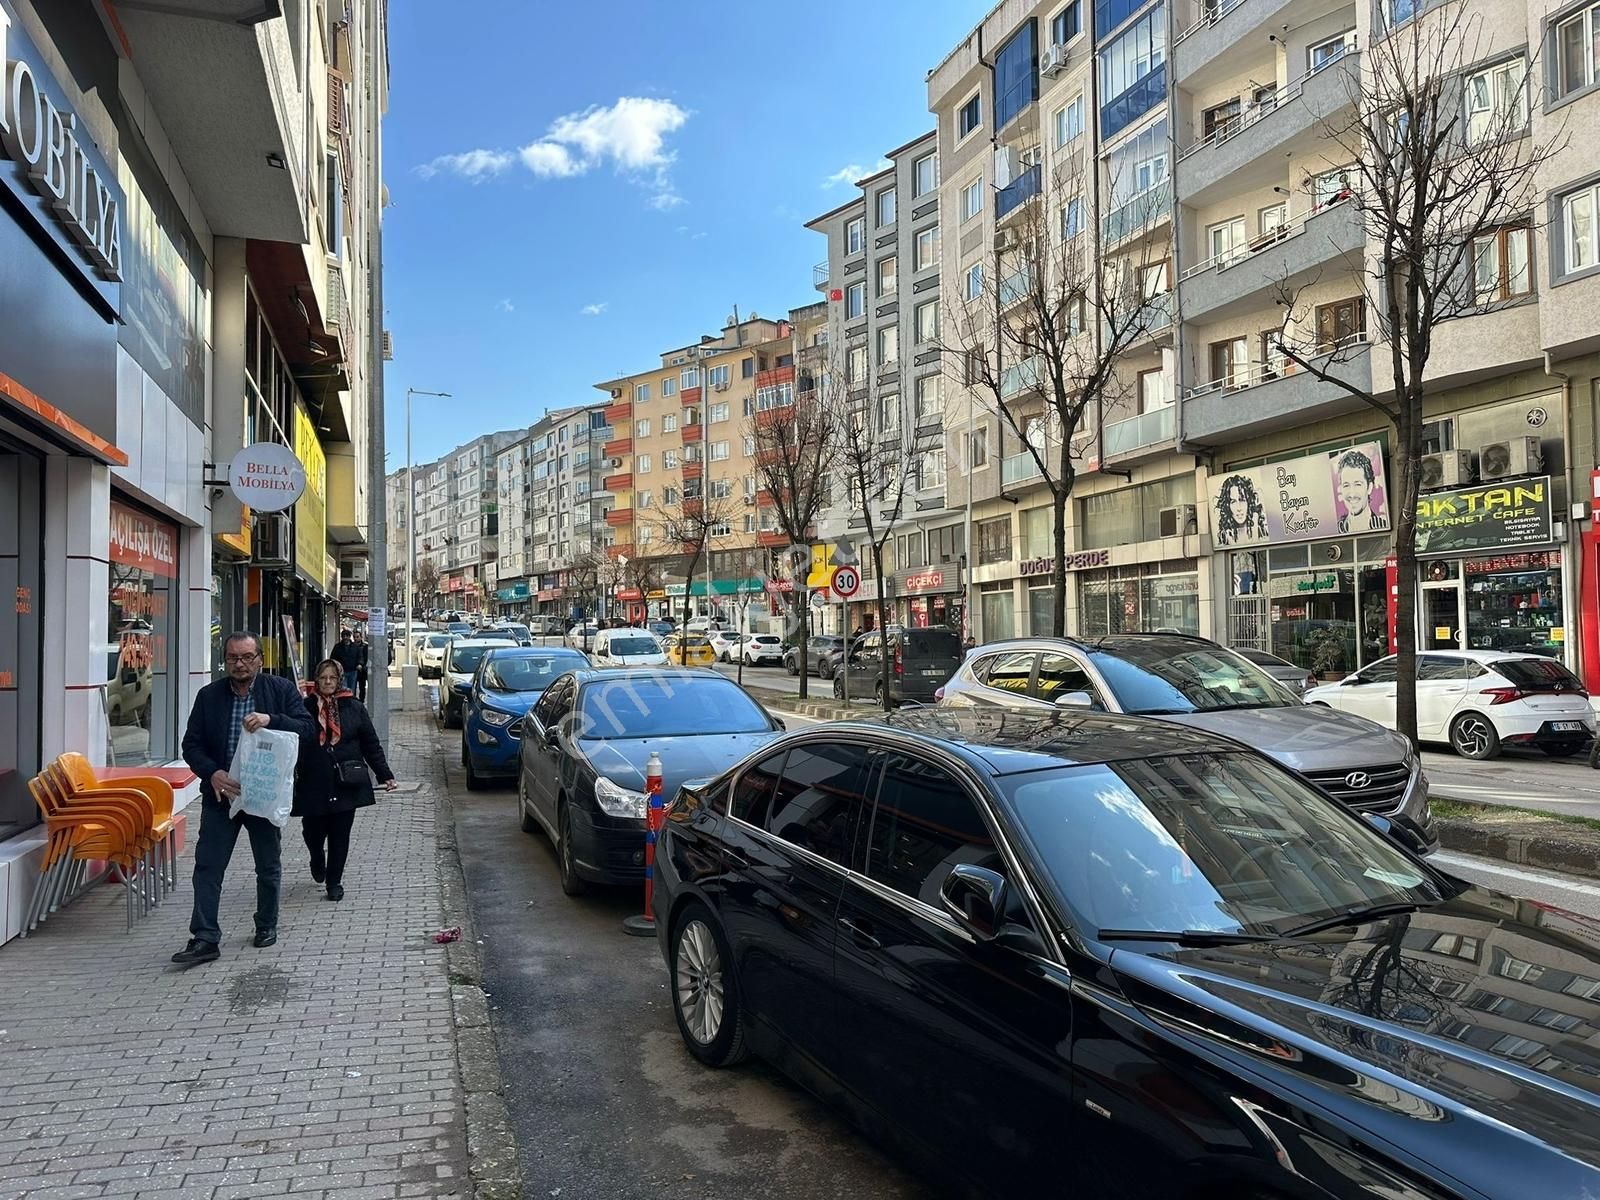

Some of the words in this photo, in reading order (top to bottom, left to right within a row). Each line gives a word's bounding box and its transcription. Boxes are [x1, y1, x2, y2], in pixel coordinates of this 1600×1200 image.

[246, 461, 289, 476] BELLA
[1276, 466, 1296, 488] Bay
[238, 475, 296, 492] MOBİLYA
[1279, 490, 1310, 512] Bayan
[1416, 483, 1543, 518] AKTAN
[1282, 510, 1320, 535] Kuaför
[1416, 513, 1486, 529] NTERNET
[1493, 507, 1537, 520] CAFE
[1505, 522, 1540, 530] NOTEBOOK
[110, 508, 150, 562] AÇILIŞA
[152, 522, 173, 565] ÖZEL
[1066, 550, 1109, 569] PERDE
[837, 574, 854, 589] 30
[906, 574, 942, 590] ÇİÇEKÇİ
